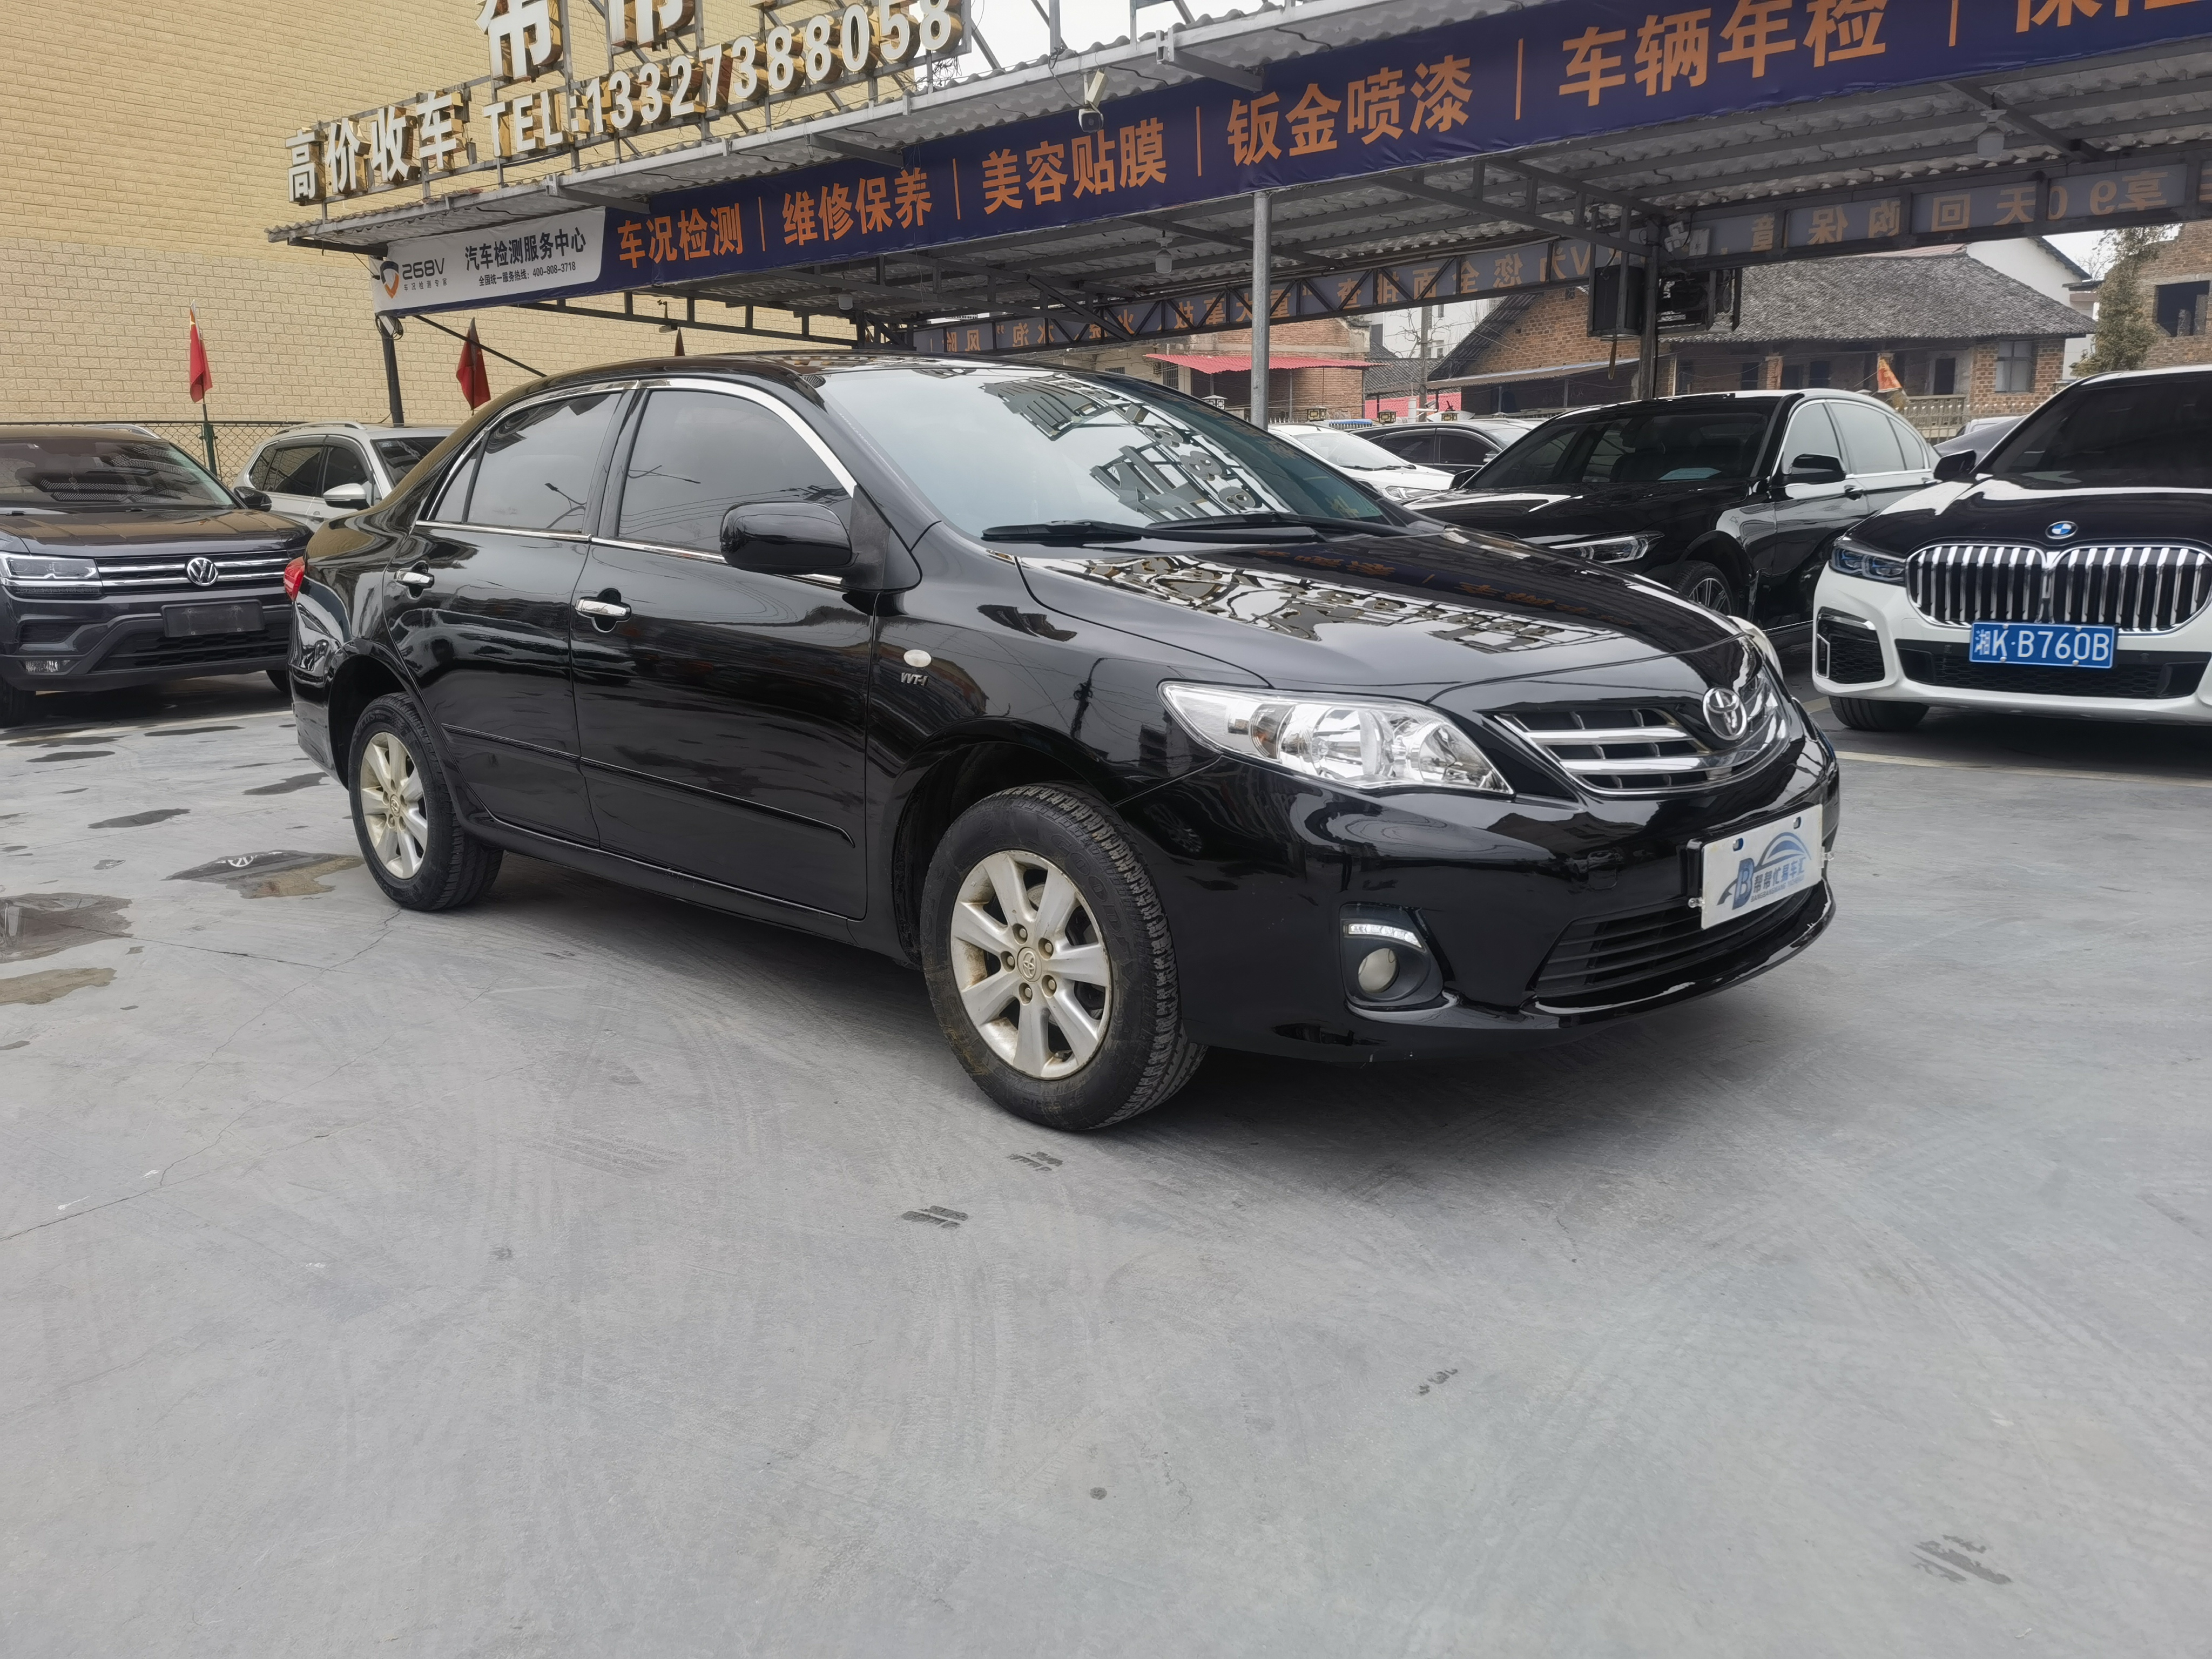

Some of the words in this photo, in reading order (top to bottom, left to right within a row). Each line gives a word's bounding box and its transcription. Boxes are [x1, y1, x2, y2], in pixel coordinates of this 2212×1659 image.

[285, 90, 459, 204] 高价收车
[617, 203, 743, 268] 车况检测
[783, 167, 933, 246] 维修保养
[982, 116, 1168, 215] 美容贴膜
[1227, 54, 1474, 167] 钣金喷漆
[1559, 0, 1886, 107] 车辆年检
[402, 258, 444, 280] 268V
[464, 227, 586, 271] 汽车检测服务中心
